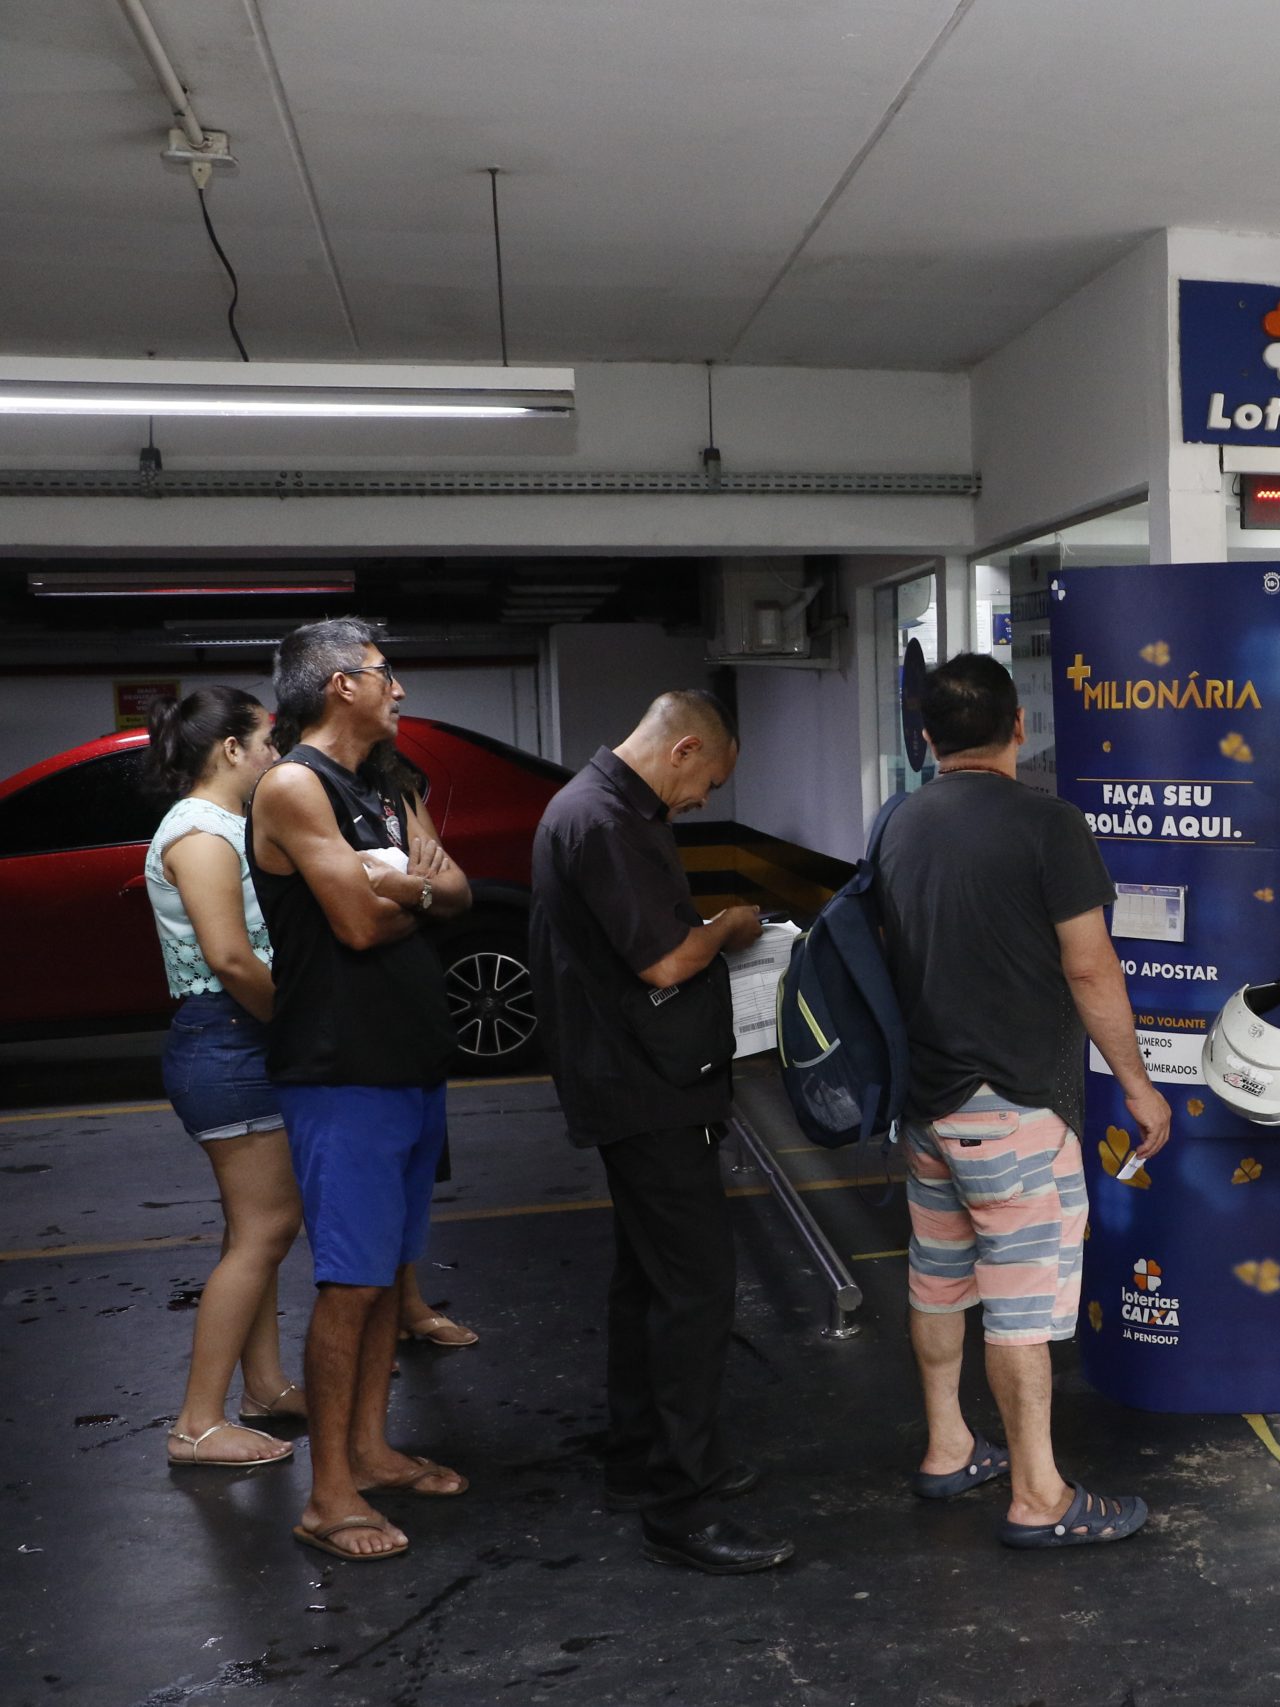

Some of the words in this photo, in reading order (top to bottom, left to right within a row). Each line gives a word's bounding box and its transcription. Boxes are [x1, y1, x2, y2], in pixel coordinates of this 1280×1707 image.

[1103, 784, 1154, 810] FAÇA
[1163, 785, 1212, 807] SEU
[1085, 809, 1153, 836] BOLÃO
[1161, 815, 1242, 838] AQUI.
[1141, 962, 1218, 981] APOSTAR
[1140, 1015, 1155, 1025] NO
[1157, 1017, 1206, 1029] VOLANTE
[1121, 1286, 1180, 1309] loterias
[1121, 1304, 1180, 1326] CAIXA
[1123, 1328, 1132, 1340] JÁ
[1134, 1332, 1179, 1345] PENSOU?
